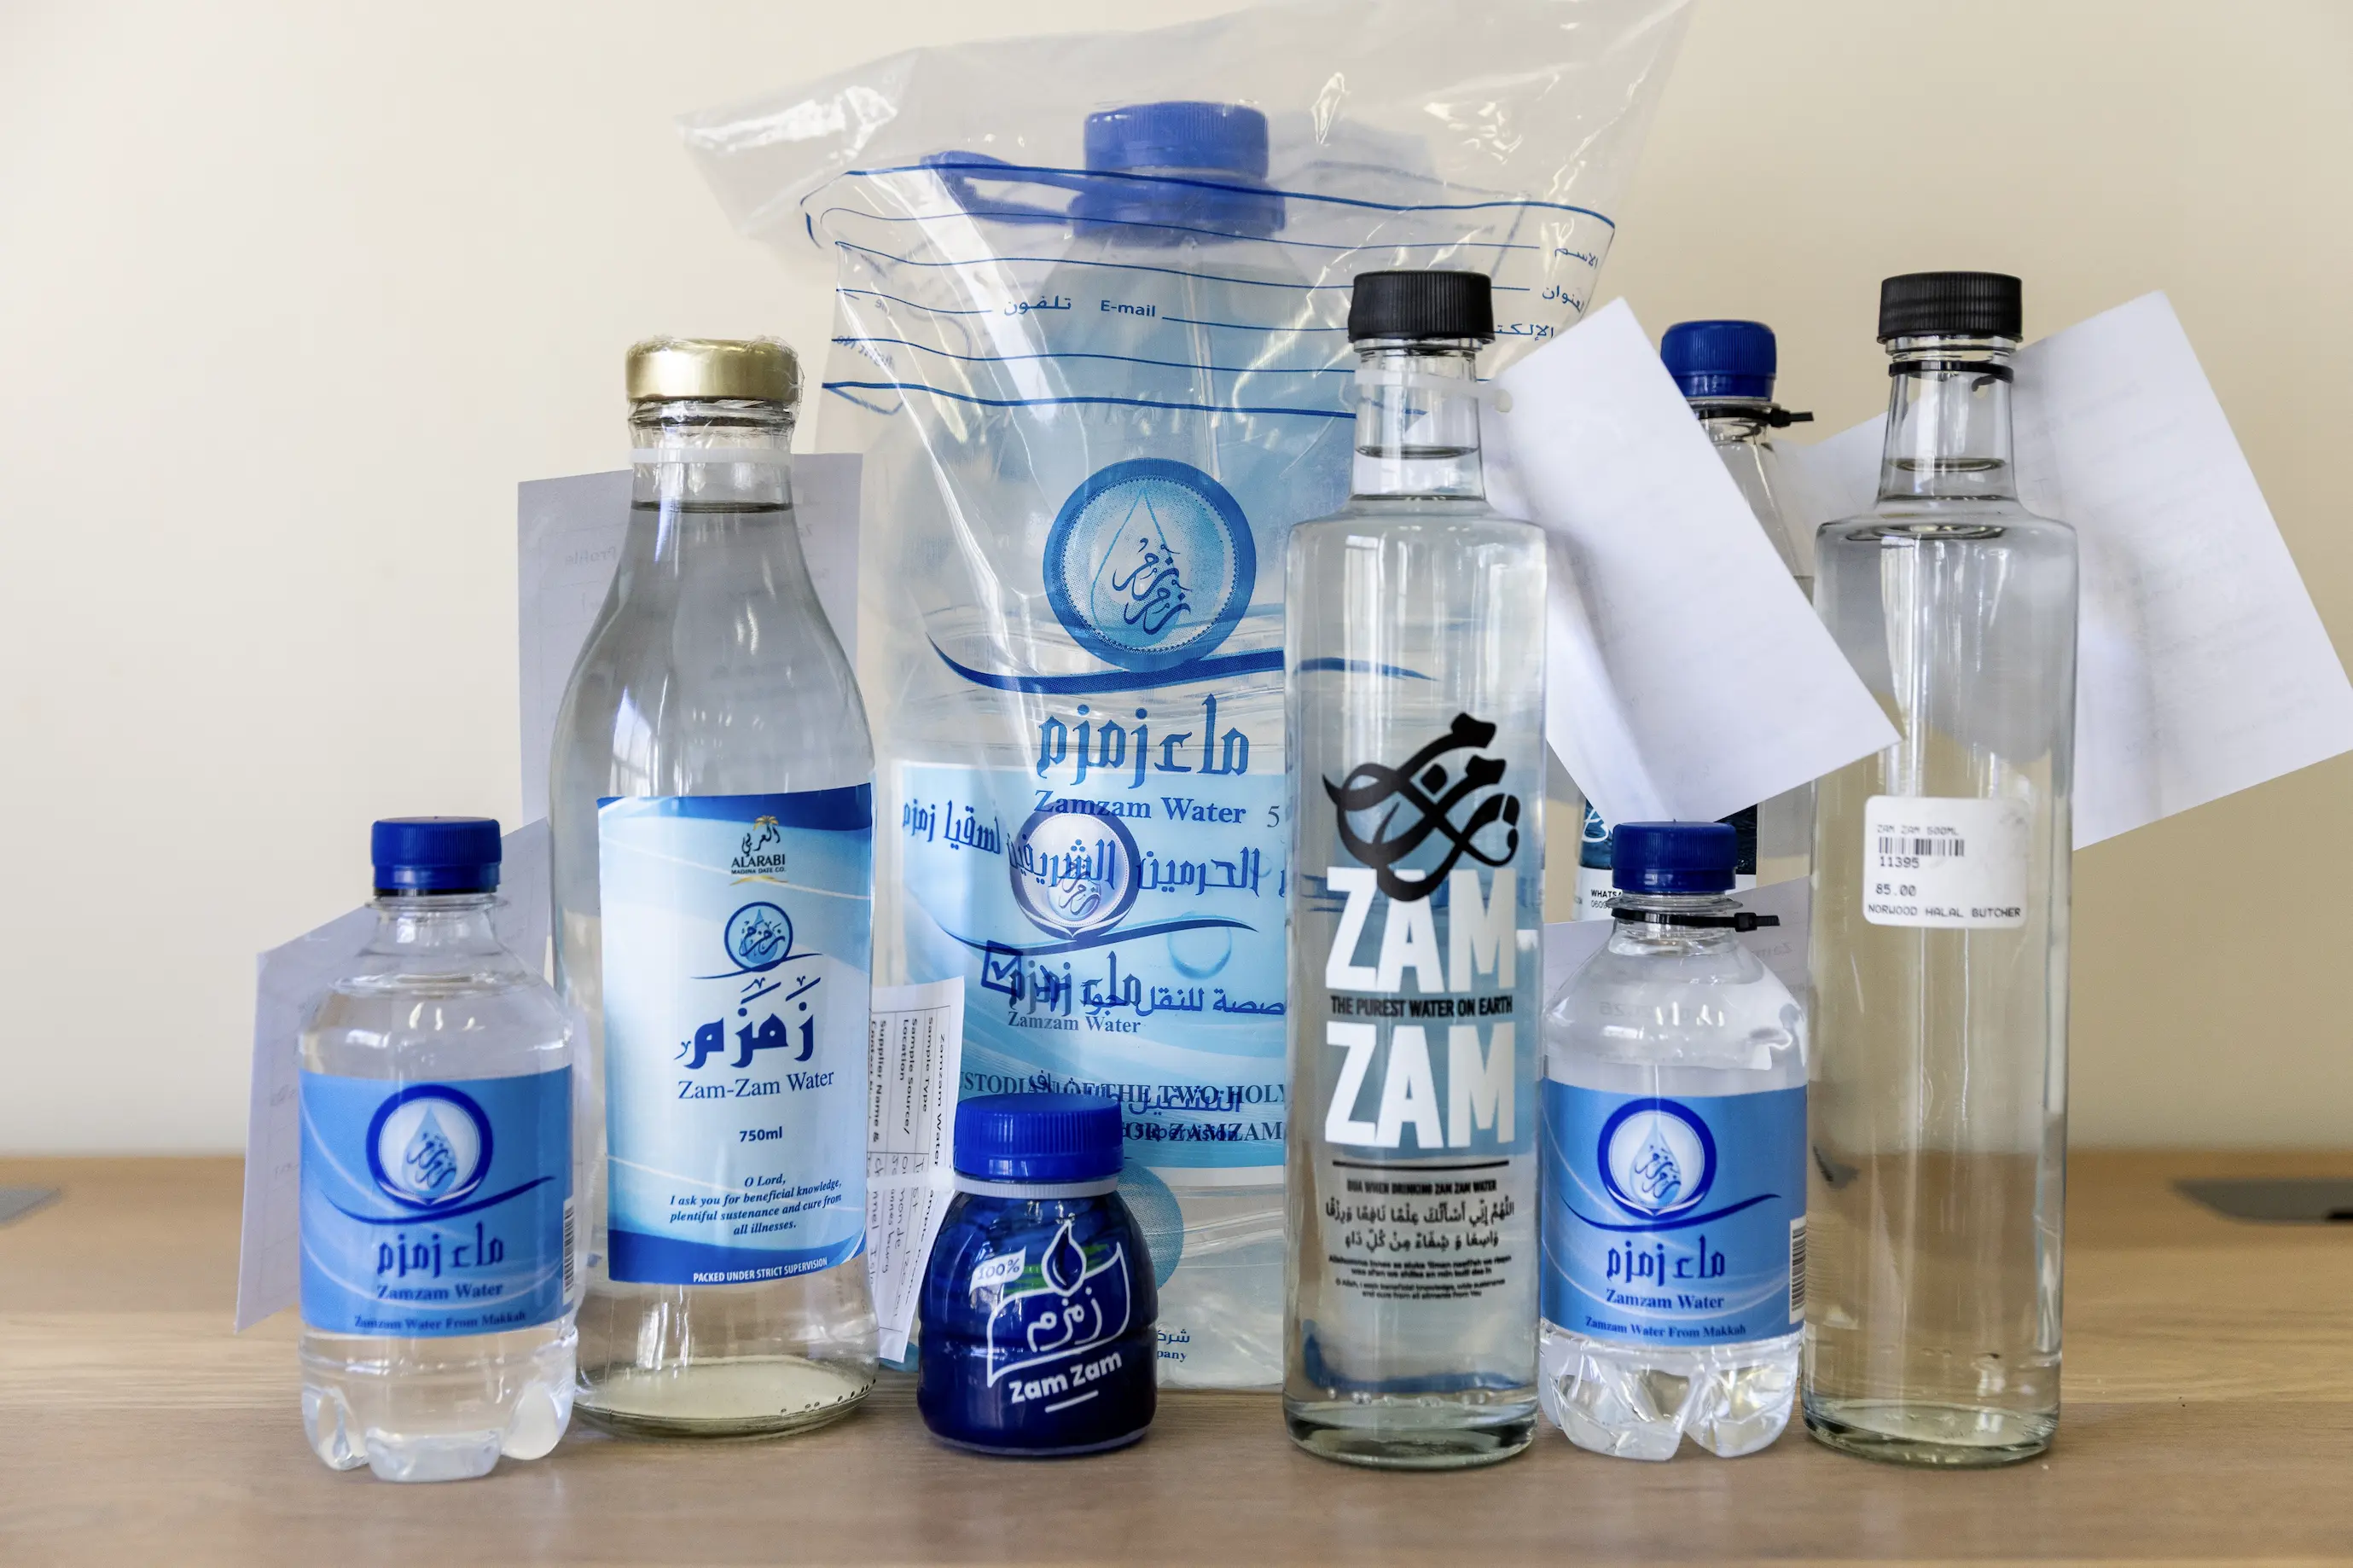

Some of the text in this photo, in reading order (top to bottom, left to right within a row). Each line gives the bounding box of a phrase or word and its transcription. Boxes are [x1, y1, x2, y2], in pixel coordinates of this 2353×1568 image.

[1004, 295, 1072, 317] تلفون
[1100, 299, 1157, 317] E-mail
[1035, 704, 1148, 789] زمزم
[1034, 790, 1152, 819] Zamzam
[1160, 797, 1246, 824] Water
[730, 854, 786, 868] ALARABI
[1879, 857, 1920, 868] 11395
[1868, 904, 2021, 918] NORWOOD HALAL BUTCHER
[1326, 867, 1517, 993] ZAM
[1330, 996, 1513, 1018] THE PUREST WATER ON EARTH
[1008, 1011, 1142, 1033] Zamzam Water
[898, 1019, 909, 1081] Location
[908, 1018, 918, 1072] Sample
[677, 1071, 834, 1100] Zam-Zam Water
[1158, 1085, 1219, 1105] TWO
[1324, 1021, 1516, 1149] ZAM
[739, 1126, 783, 1143] 750ml
[1169, 1121, 1283, 1141] ZAMZAM
[744, 1173, 787, 1188] O Lord,
[670, 1178, 842, 1208] I ask you for beneficial knowledge,
[670, 1194, 842, 1223] plentiful sustenance and cure from
[733, 1221, 797, 1235] all illnesses.
[693, 1257, 828, 1283] PACKED UNDER STRICT SUPERVISION
[976, 1257, 1021, 1281] 100%
[376, 1281, 503, 1301] Zamzam Water
[1606, 1288, 1725, 1310] Zamzam Water
[354, 1310, 526, 1331] Zamzam Water From Makkah
[1585, 1315, 1746, 1339] Zamzam Water From Makkah
[1157, 1328, 1190, 1345] شرك
[1008, 1350, 1123, 1404] Zam Zam
